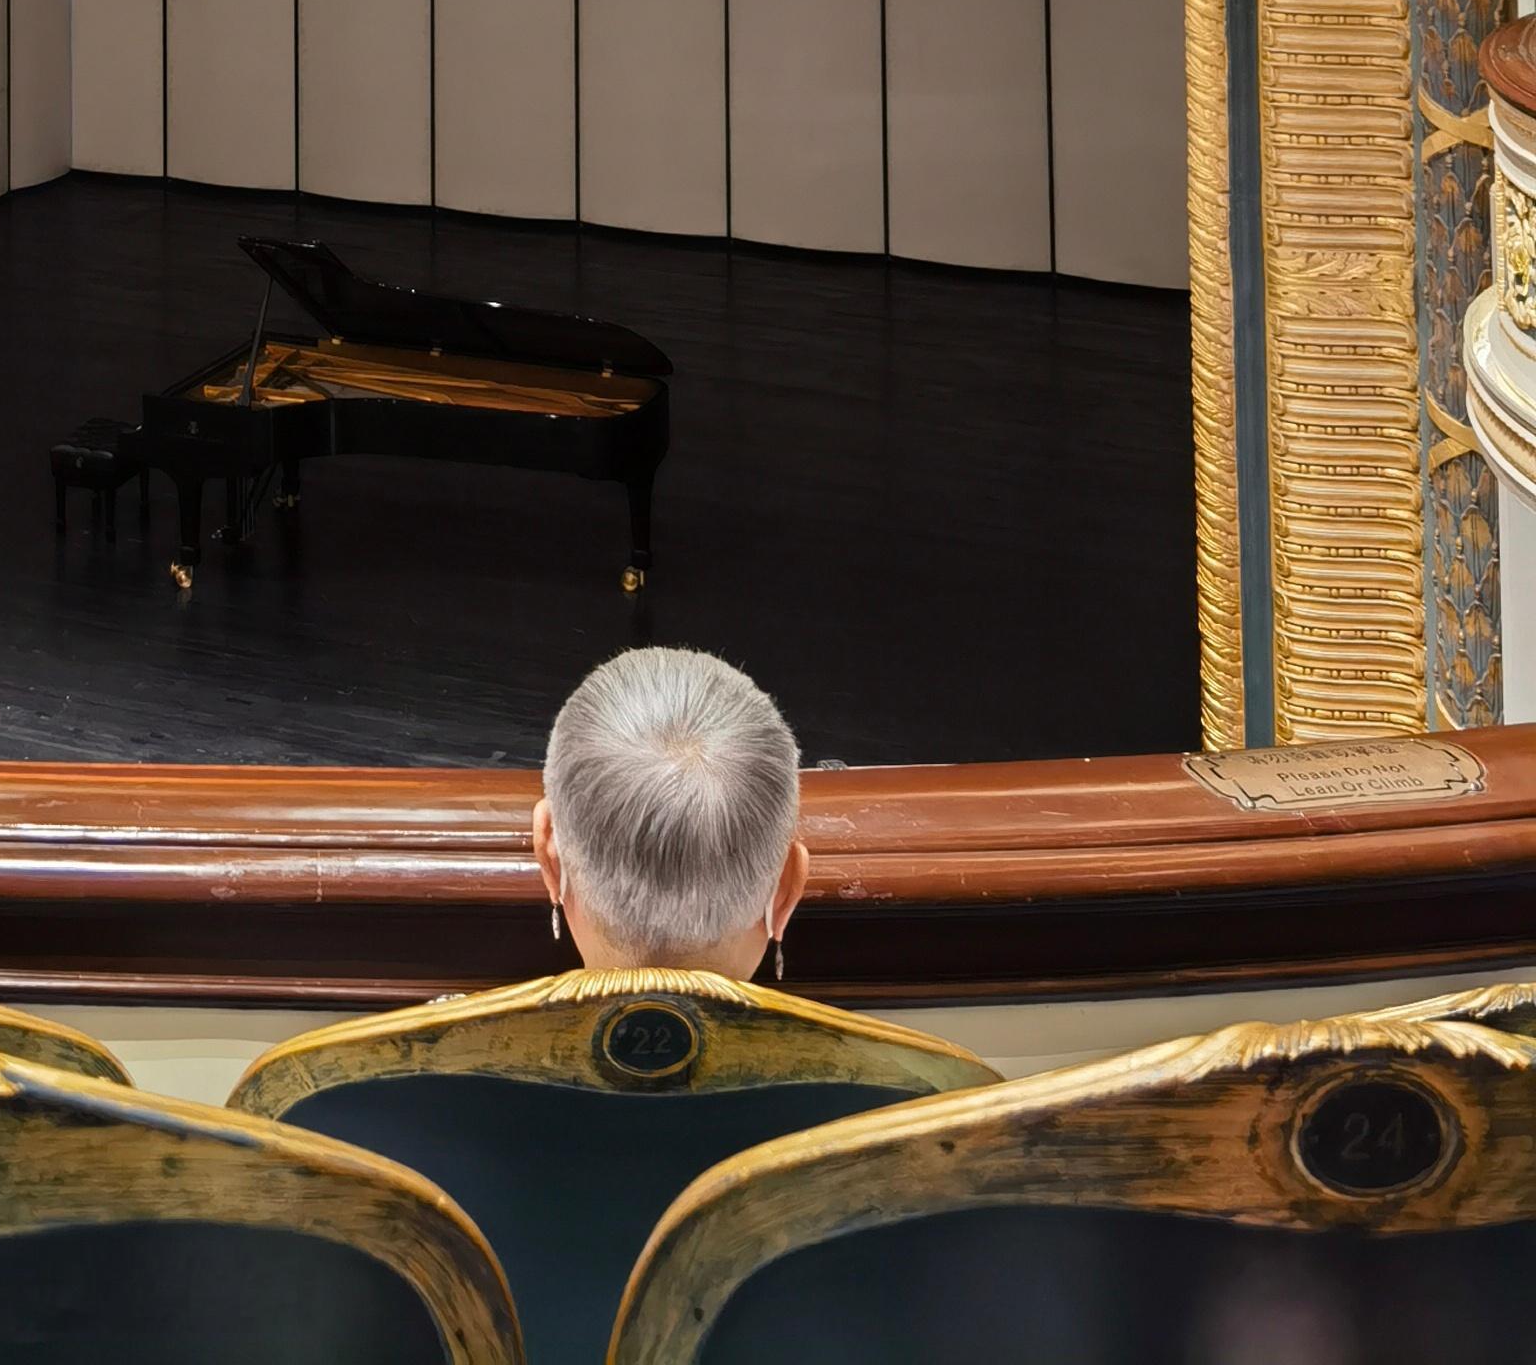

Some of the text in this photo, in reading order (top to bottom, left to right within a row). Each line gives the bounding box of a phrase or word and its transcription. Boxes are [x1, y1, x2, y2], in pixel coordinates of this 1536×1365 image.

[1276, 769, 1342, 783] Please
[1343, 766, 1372, 777] Do
[1289, 775, 1424, 797] Lean Or Climb
[632, 1026, 672, 1055] 22
[1340, 1112, 1406, 1161] 24
